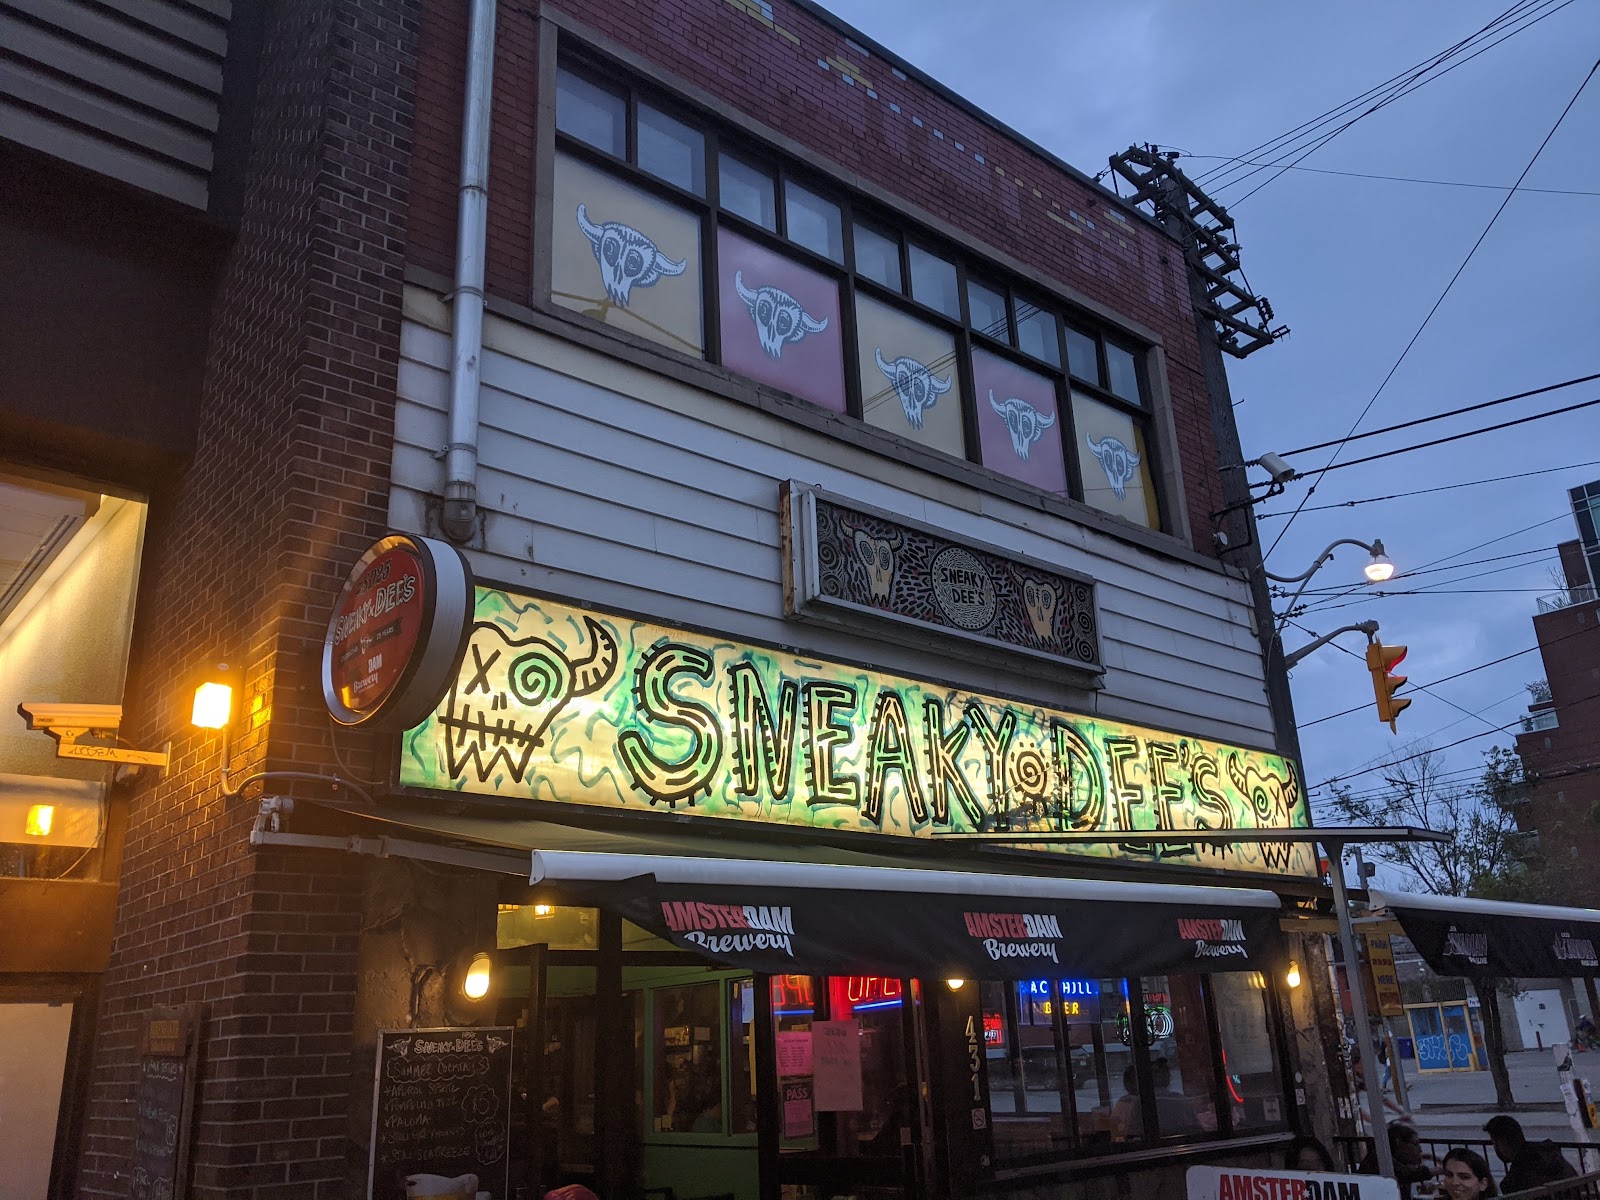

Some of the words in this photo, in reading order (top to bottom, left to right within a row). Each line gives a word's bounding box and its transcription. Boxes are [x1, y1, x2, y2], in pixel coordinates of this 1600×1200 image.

[941, 567, 985, 589] SNEAKY
[374, 573, 416, 618] DEE'S
[952, 589, 985, 606] DEE'S
[618, 640, 1017, 832] SNEAKY
[1050, 719, 1234, 857] DEE'S
[661, 901, 795, 936] AMSTERDAM
[963, 911, 1064, 939] AMSTERDAM
[1177, 918, 1247, 941] AMSTERDAM
[982, 938, 1060, 964] Brewery
[1194, 939, 1249, 959] Brewery
[1370, 940, 1389, 951] PARK
[1378, 977, 1397, 988] HERE
[414, 1038, 453, 1054] SNEAKY
[455, 1037, 484, 1053] DEE'S
[965, 1015, 981, 1101] 431
[786, 1088, 808, 1101] PASS
